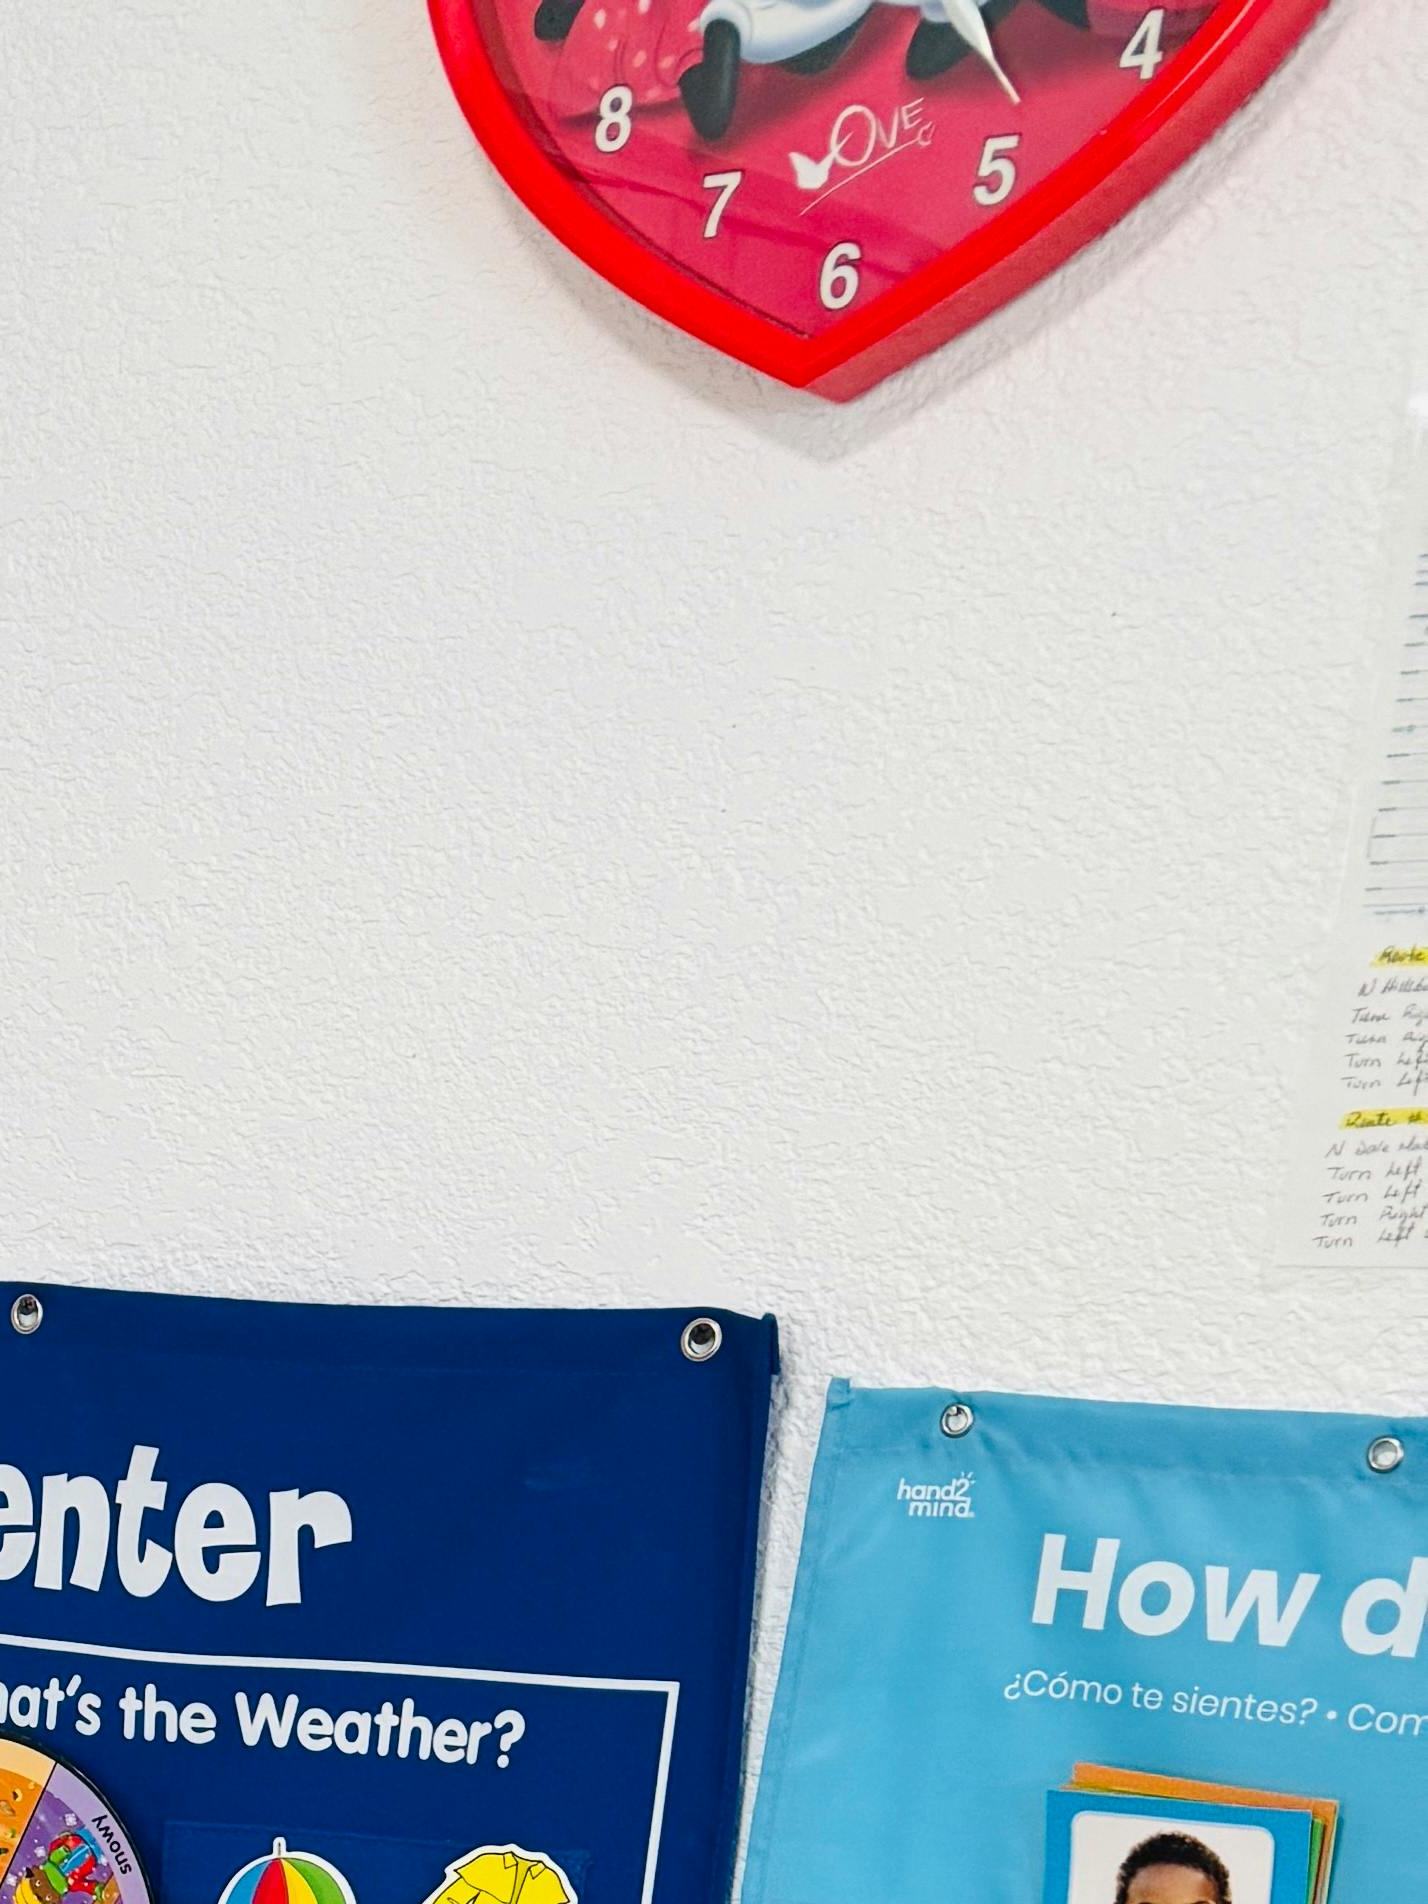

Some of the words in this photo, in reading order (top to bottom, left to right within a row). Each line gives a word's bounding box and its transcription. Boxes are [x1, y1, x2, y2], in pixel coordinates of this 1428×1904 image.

[1121, 10, 1161, 79] 4
[596, 87, 633, 153] 8
[975, 136, 1020, 204] 5
[703, 171, 742, 238] 7
[819, 243, 861, 310] 6
[1031, 1532, 1320, 1648] How
[121, 1685, 216, 1746] the
[235, 1691, 526, 1769] Weather?
[1003, 1668, 1123, 1709] ¿Cómo
[1130, 1680, 1164, 1711] te
[1172, 1687, 1318, 1728] sientes?
[91, 1813, 133, 1877] snowy
